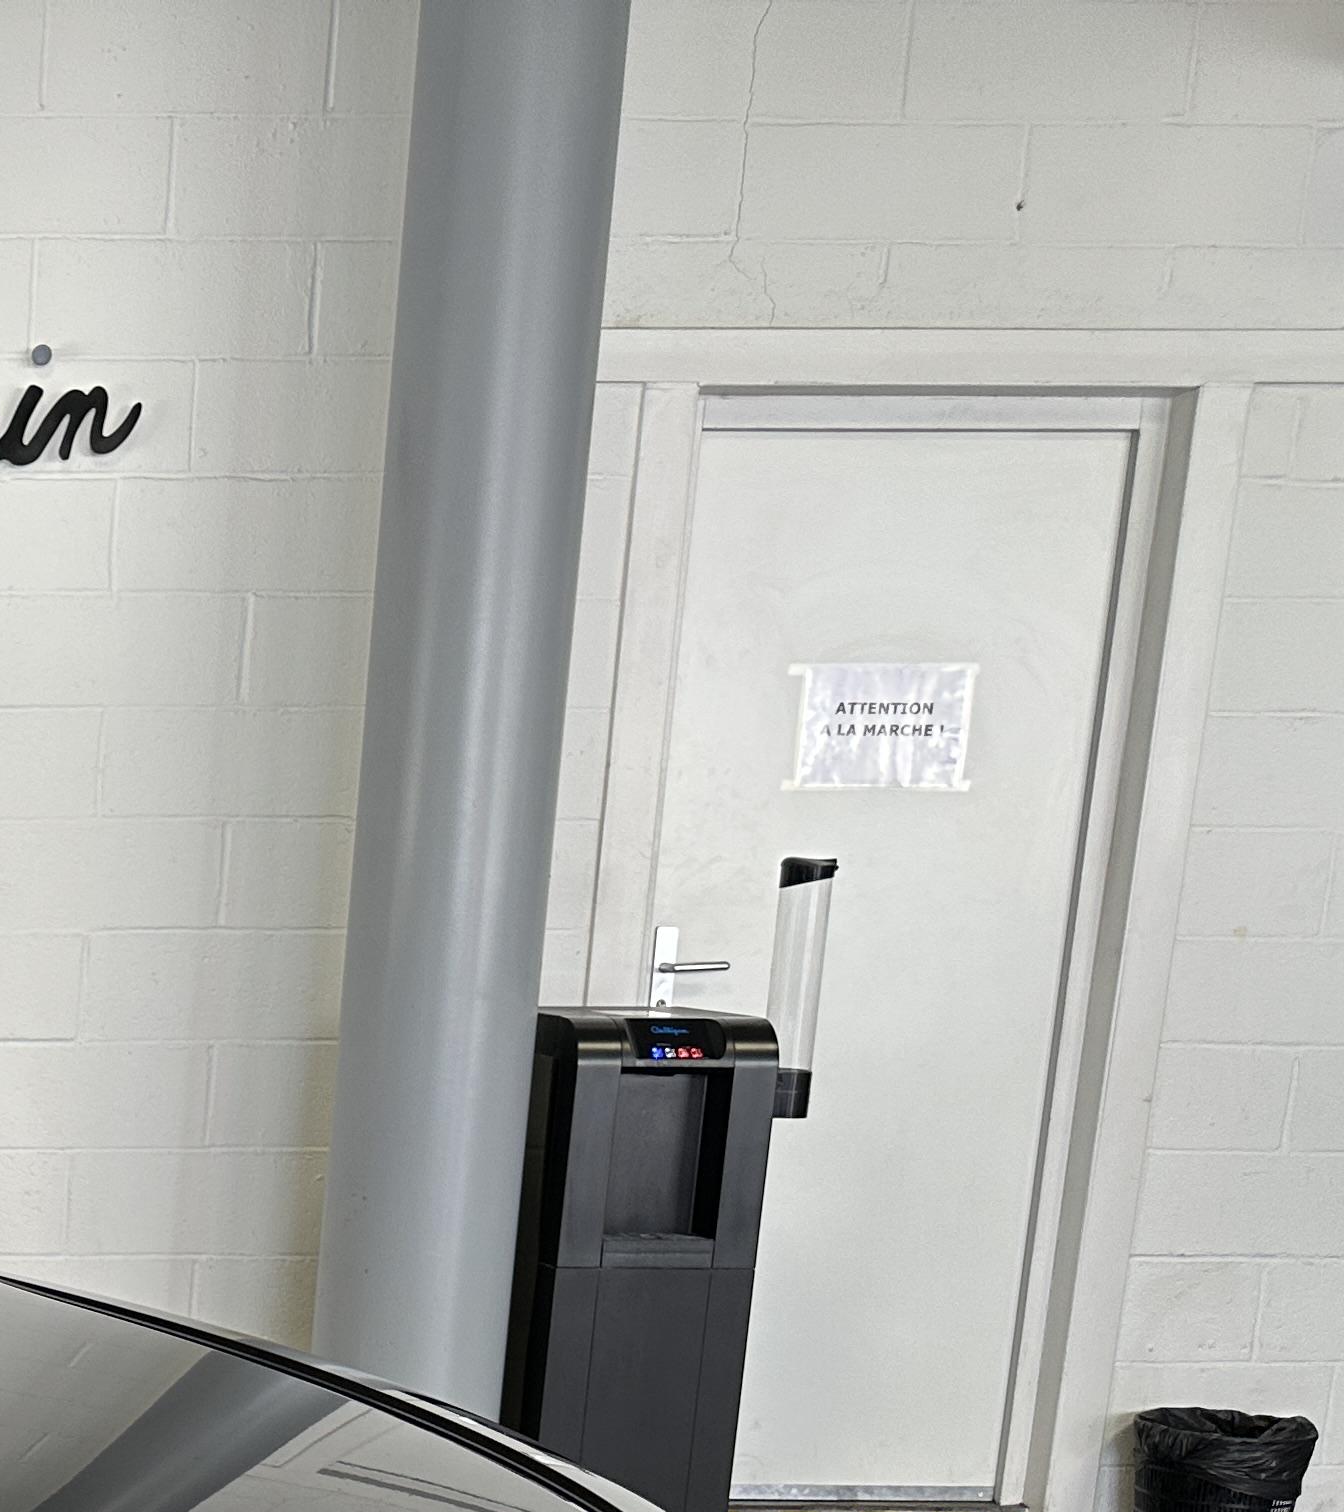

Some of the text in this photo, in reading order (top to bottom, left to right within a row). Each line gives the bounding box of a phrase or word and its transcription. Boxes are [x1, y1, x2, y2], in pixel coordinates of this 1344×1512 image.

[834, 701, 934, 716] ATTENTION
[836, 723, 857, 737] LA
[862, 723, 934, 737] MARCHE
